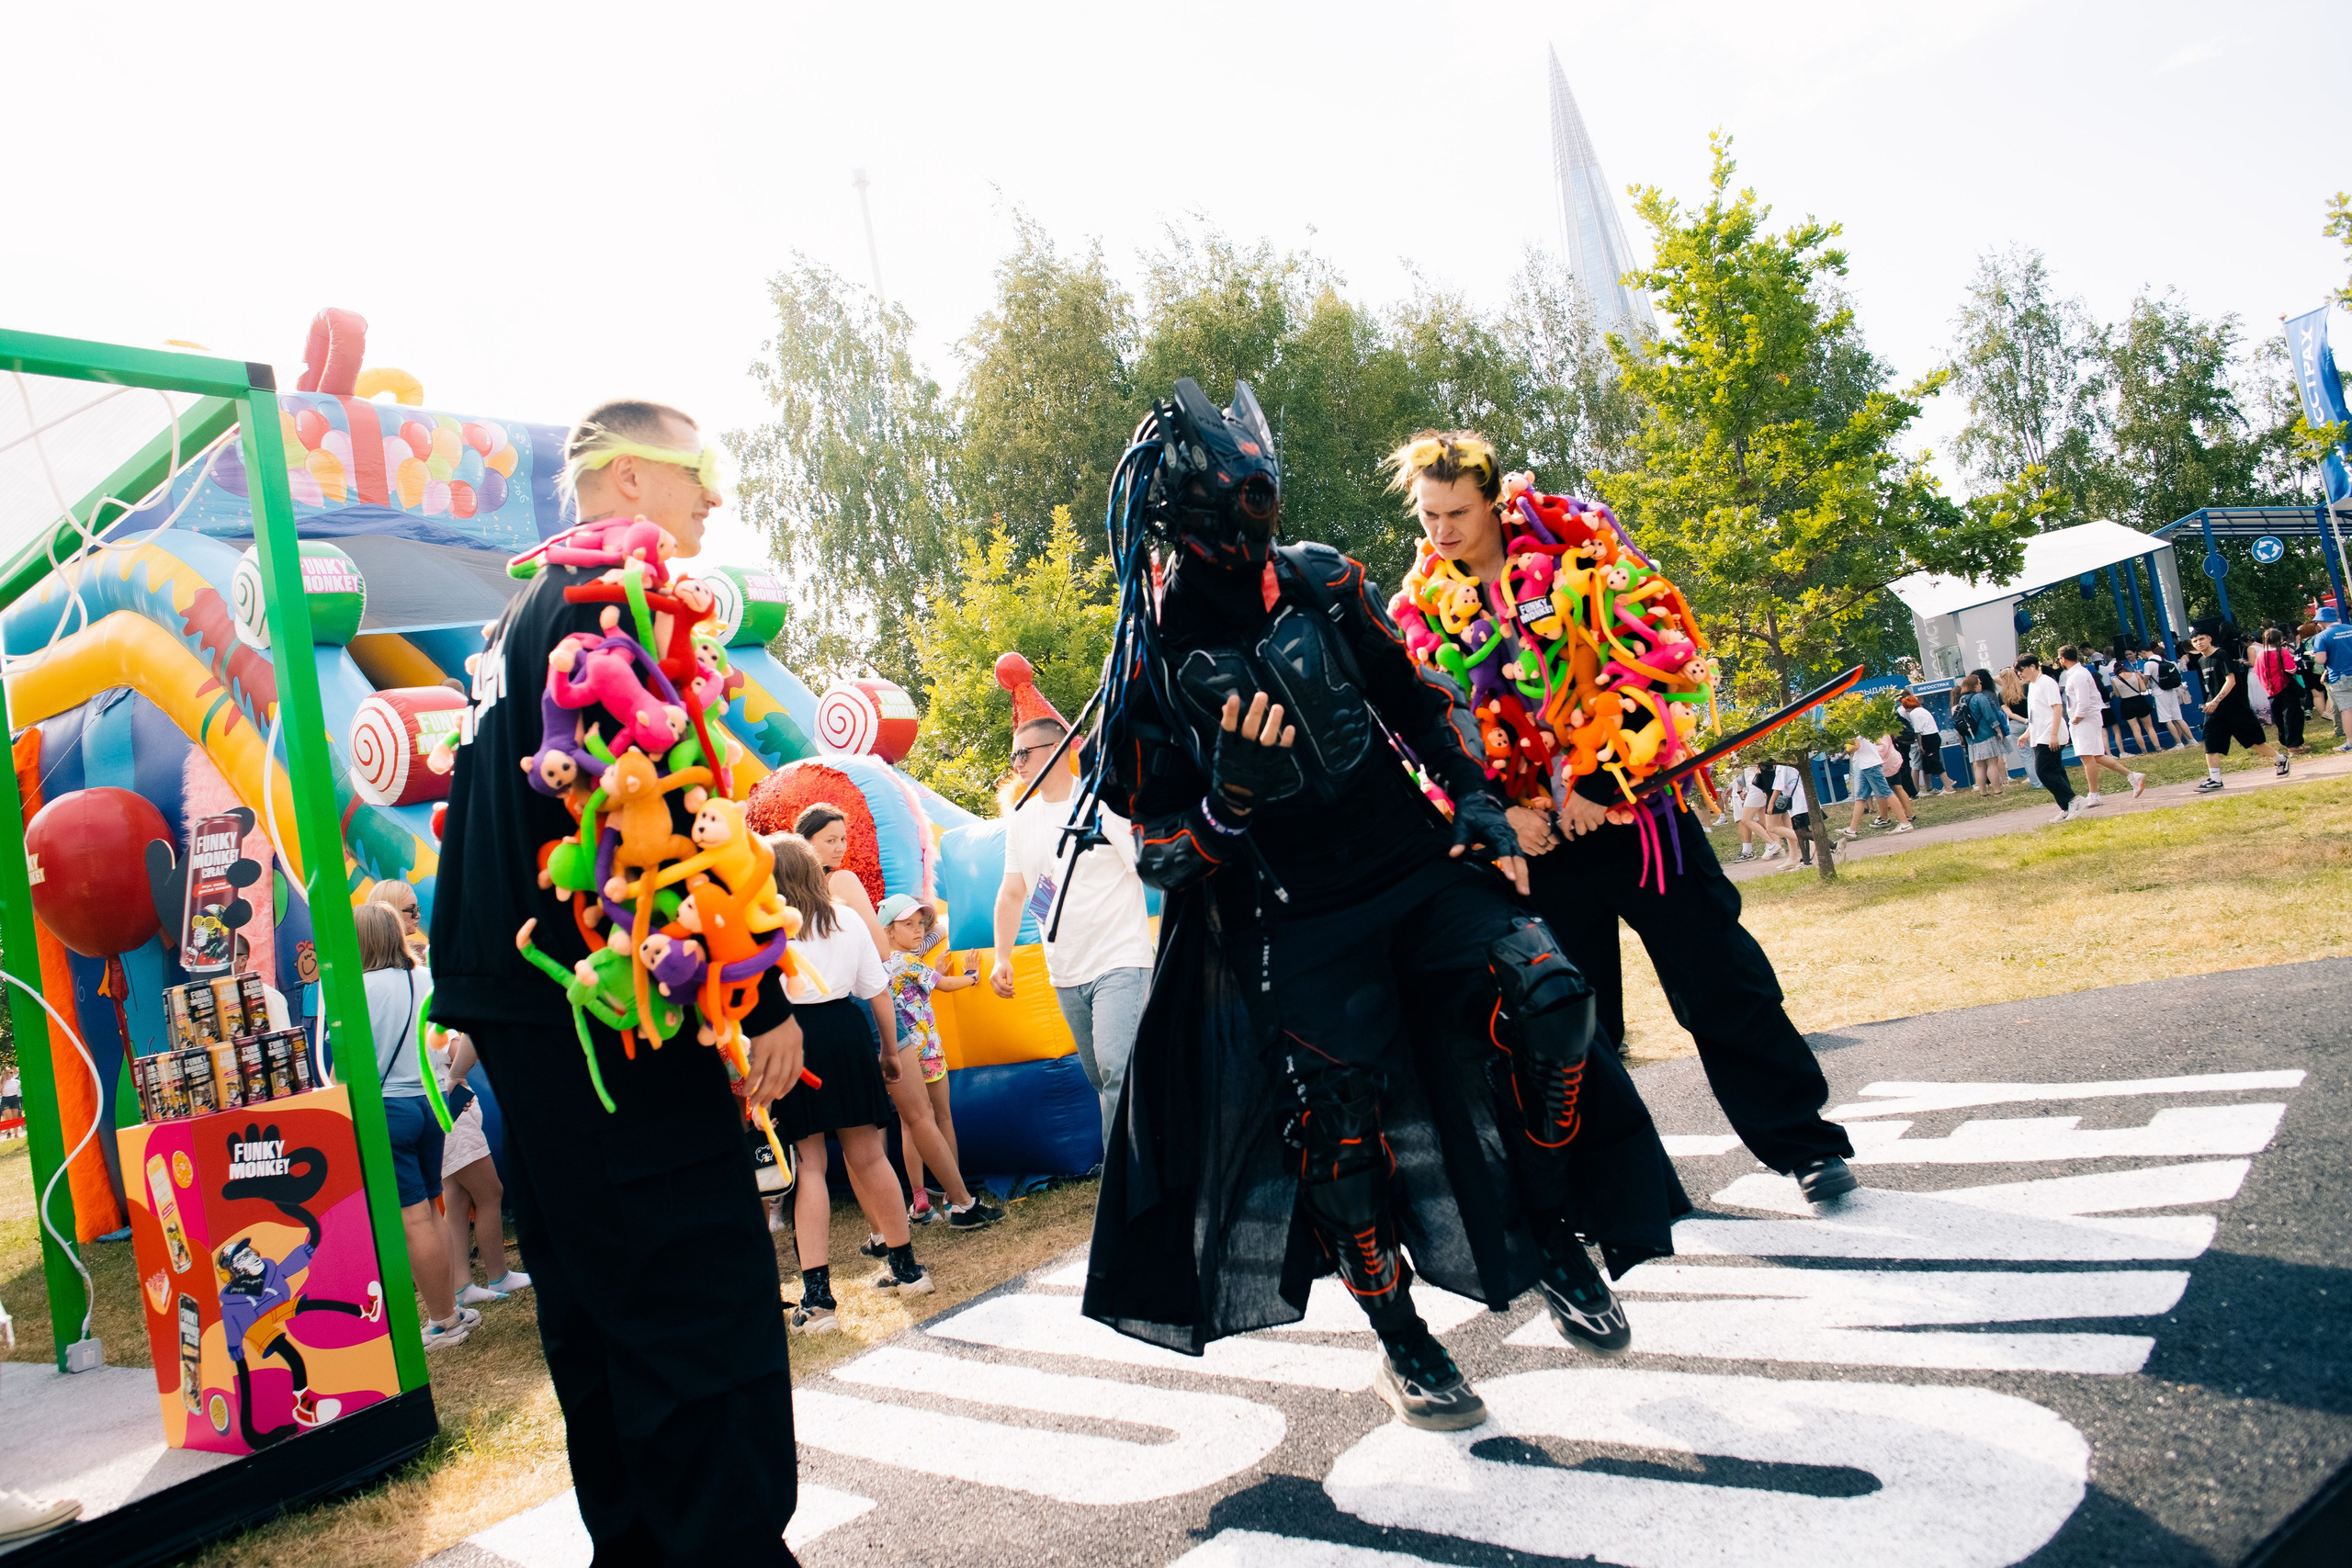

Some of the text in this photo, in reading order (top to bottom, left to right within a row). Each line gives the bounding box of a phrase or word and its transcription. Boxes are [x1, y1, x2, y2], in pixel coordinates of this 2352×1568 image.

[196, 831, 238, 854] FUNKY
[233, 1140, 285, 1163] FUNKY
[229, 1157, 290, 1180] MONKEY
[1167, 1068, 2308, 1568] ONKEY
